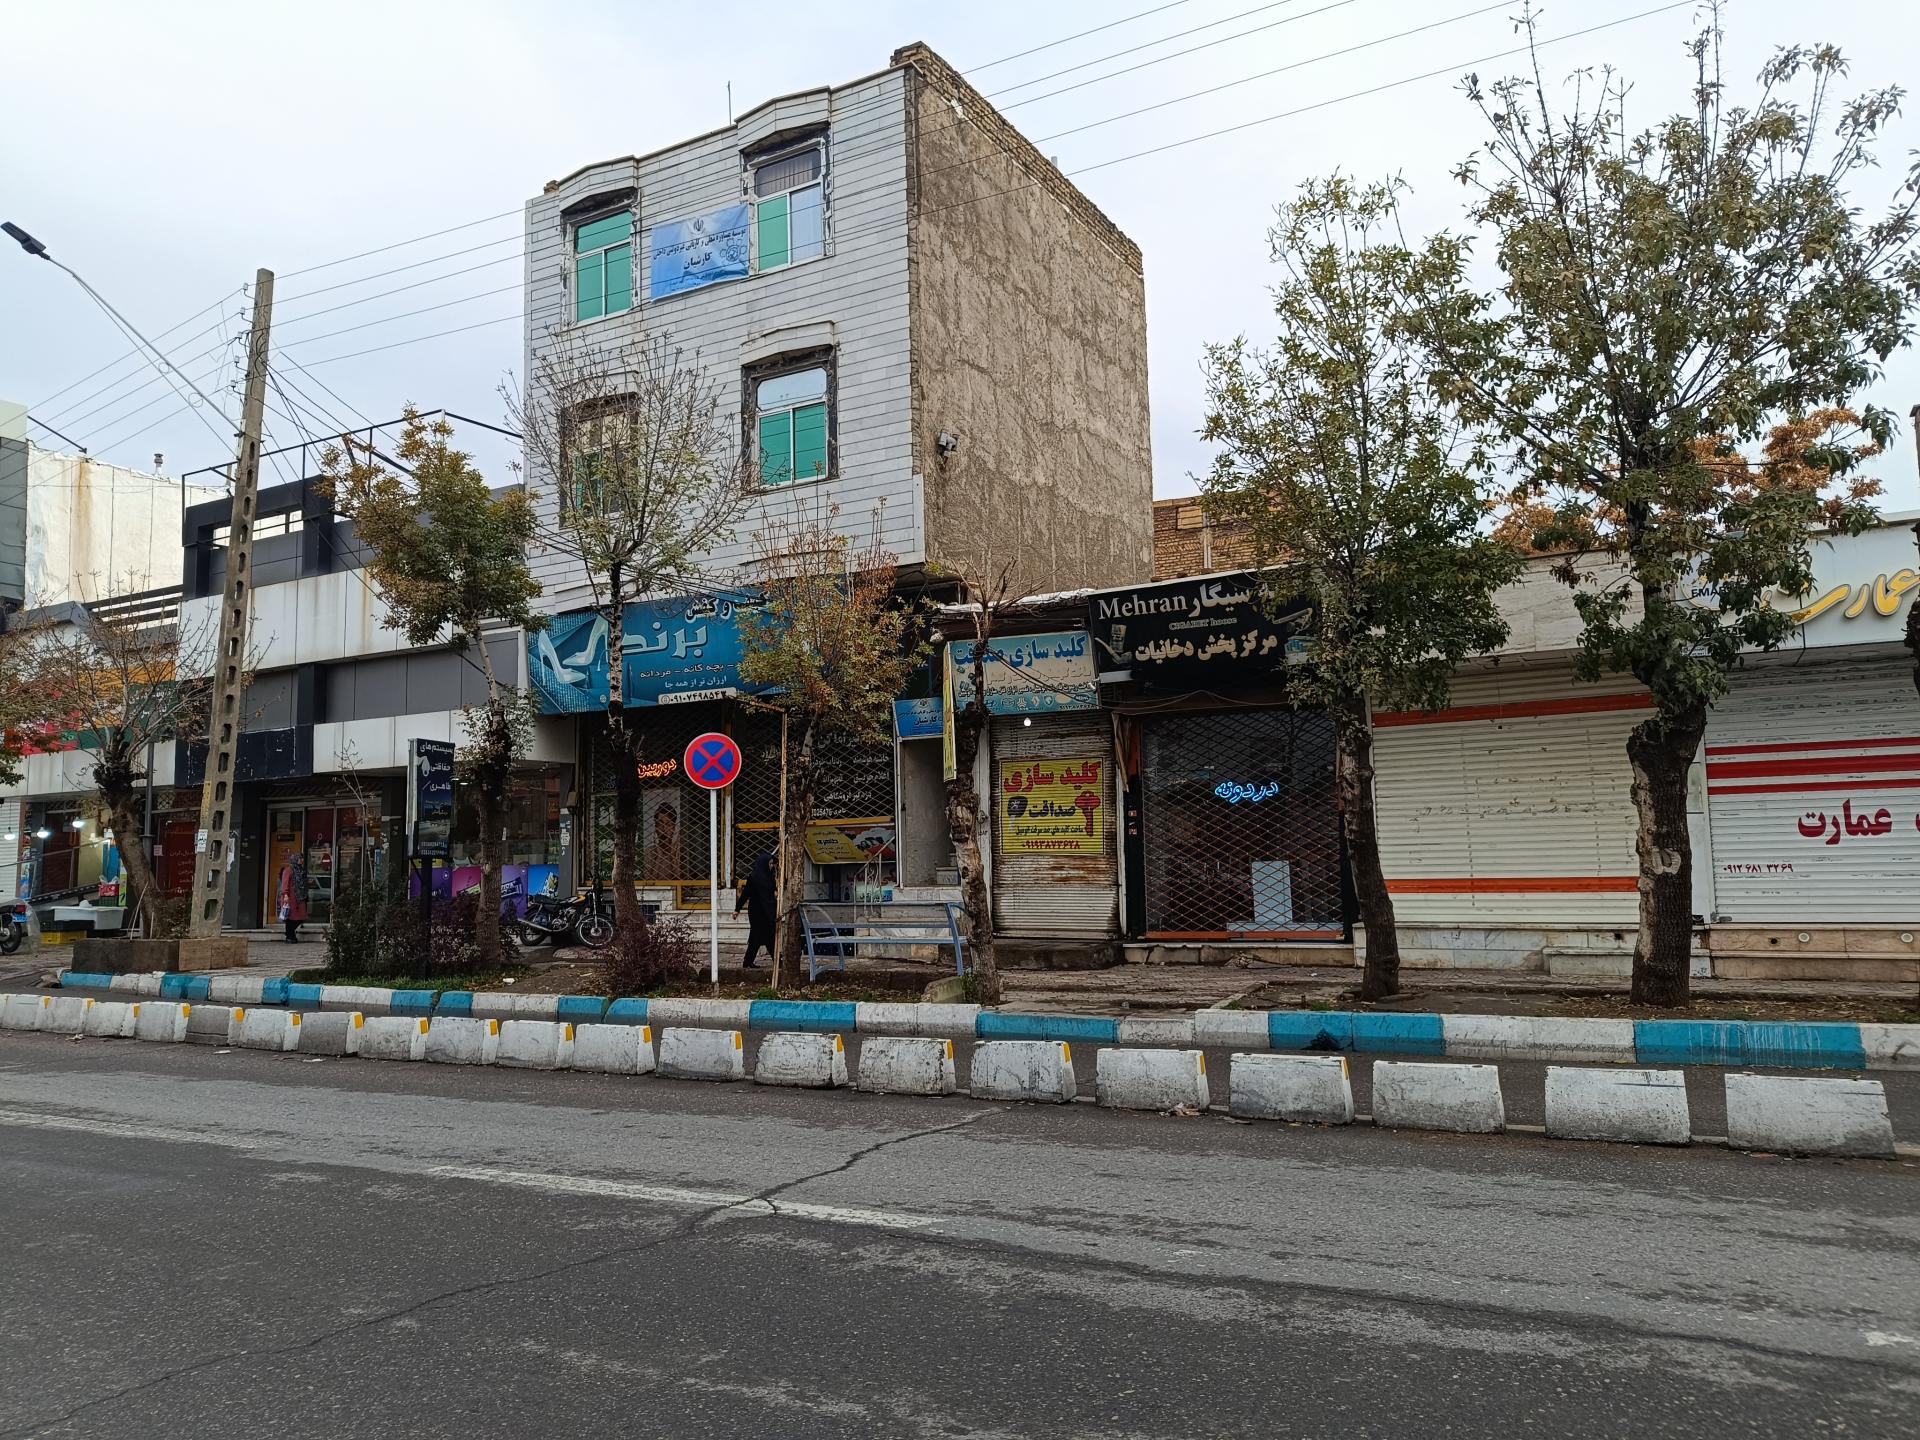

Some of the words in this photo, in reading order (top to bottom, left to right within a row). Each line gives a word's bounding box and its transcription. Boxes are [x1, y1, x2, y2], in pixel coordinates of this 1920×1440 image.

[684, 597, 720, 623] کفش
[720, 600, 732, 620] و
[1098, 592, 1188, 620] Mehran
[1188, 582, 1252, 618] سیگار
[620, 621, 709, 660] برند
[953, 642, 1005, 665] صدقت
[1009, 639, 1049, 668] سازی
[1053, 635, 1086, 663] کلید
[1135, 637, 1195, 664] دخانیات
[1198, 633, 1237, 661] پخش
[1240, 629, 1278, 658] مرکز
[640, 670, 671, 678] مردانه
[665, 681, 674, 689] جا
[690, 679, 697, 688] از
[706, 675, 727, 686] ارزان
[637, 758, 677, 778] دوربین
[1003, 762, 1055, 792] سازی
[1059, 760, 1102, 791] کلید
[429, 782, 452, 791] طاهری
[1028, 800, 1076, 817] صداقت
[1798, 798, 1893, 846] عمارت
[1723, 863, 1743, 873] ۰۹۱۲
[1745, 863, 1762, 873] ۶۸۱
[1766, 862, 1794, 873] ۳۲۶۹
